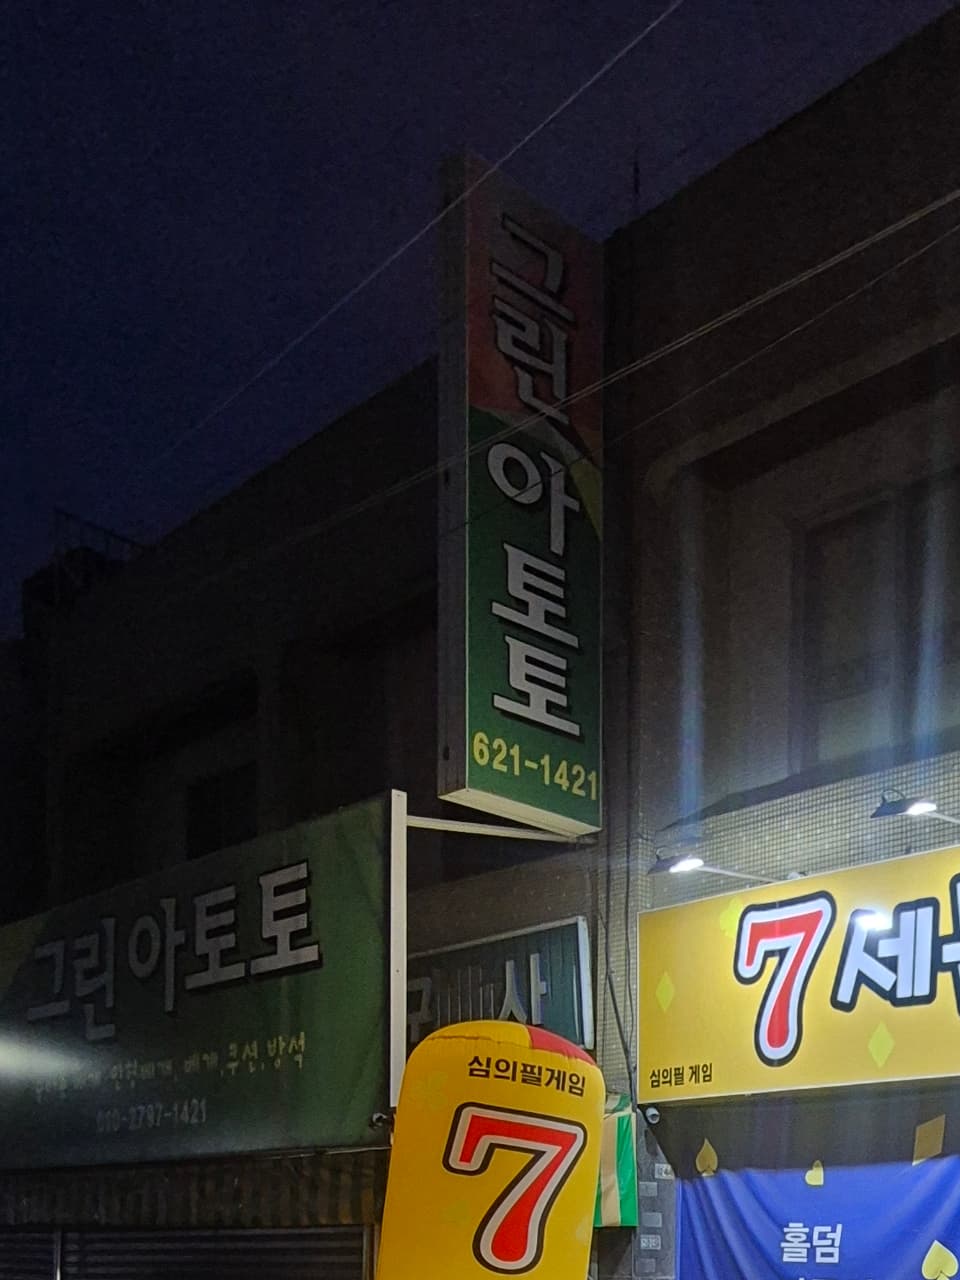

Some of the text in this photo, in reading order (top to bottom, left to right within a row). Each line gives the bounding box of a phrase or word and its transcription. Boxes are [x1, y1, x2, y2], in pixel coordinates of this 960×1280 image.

[473, 732, 598, 799] 621-1421
[26, 861, 321, 1040] 그린아토토
[467, 1054, 586, 1097] 심의필게임
[649, 1062, 713, 1088] 심의필 게임
[780, 1222, 842, 1264] 홀덤
